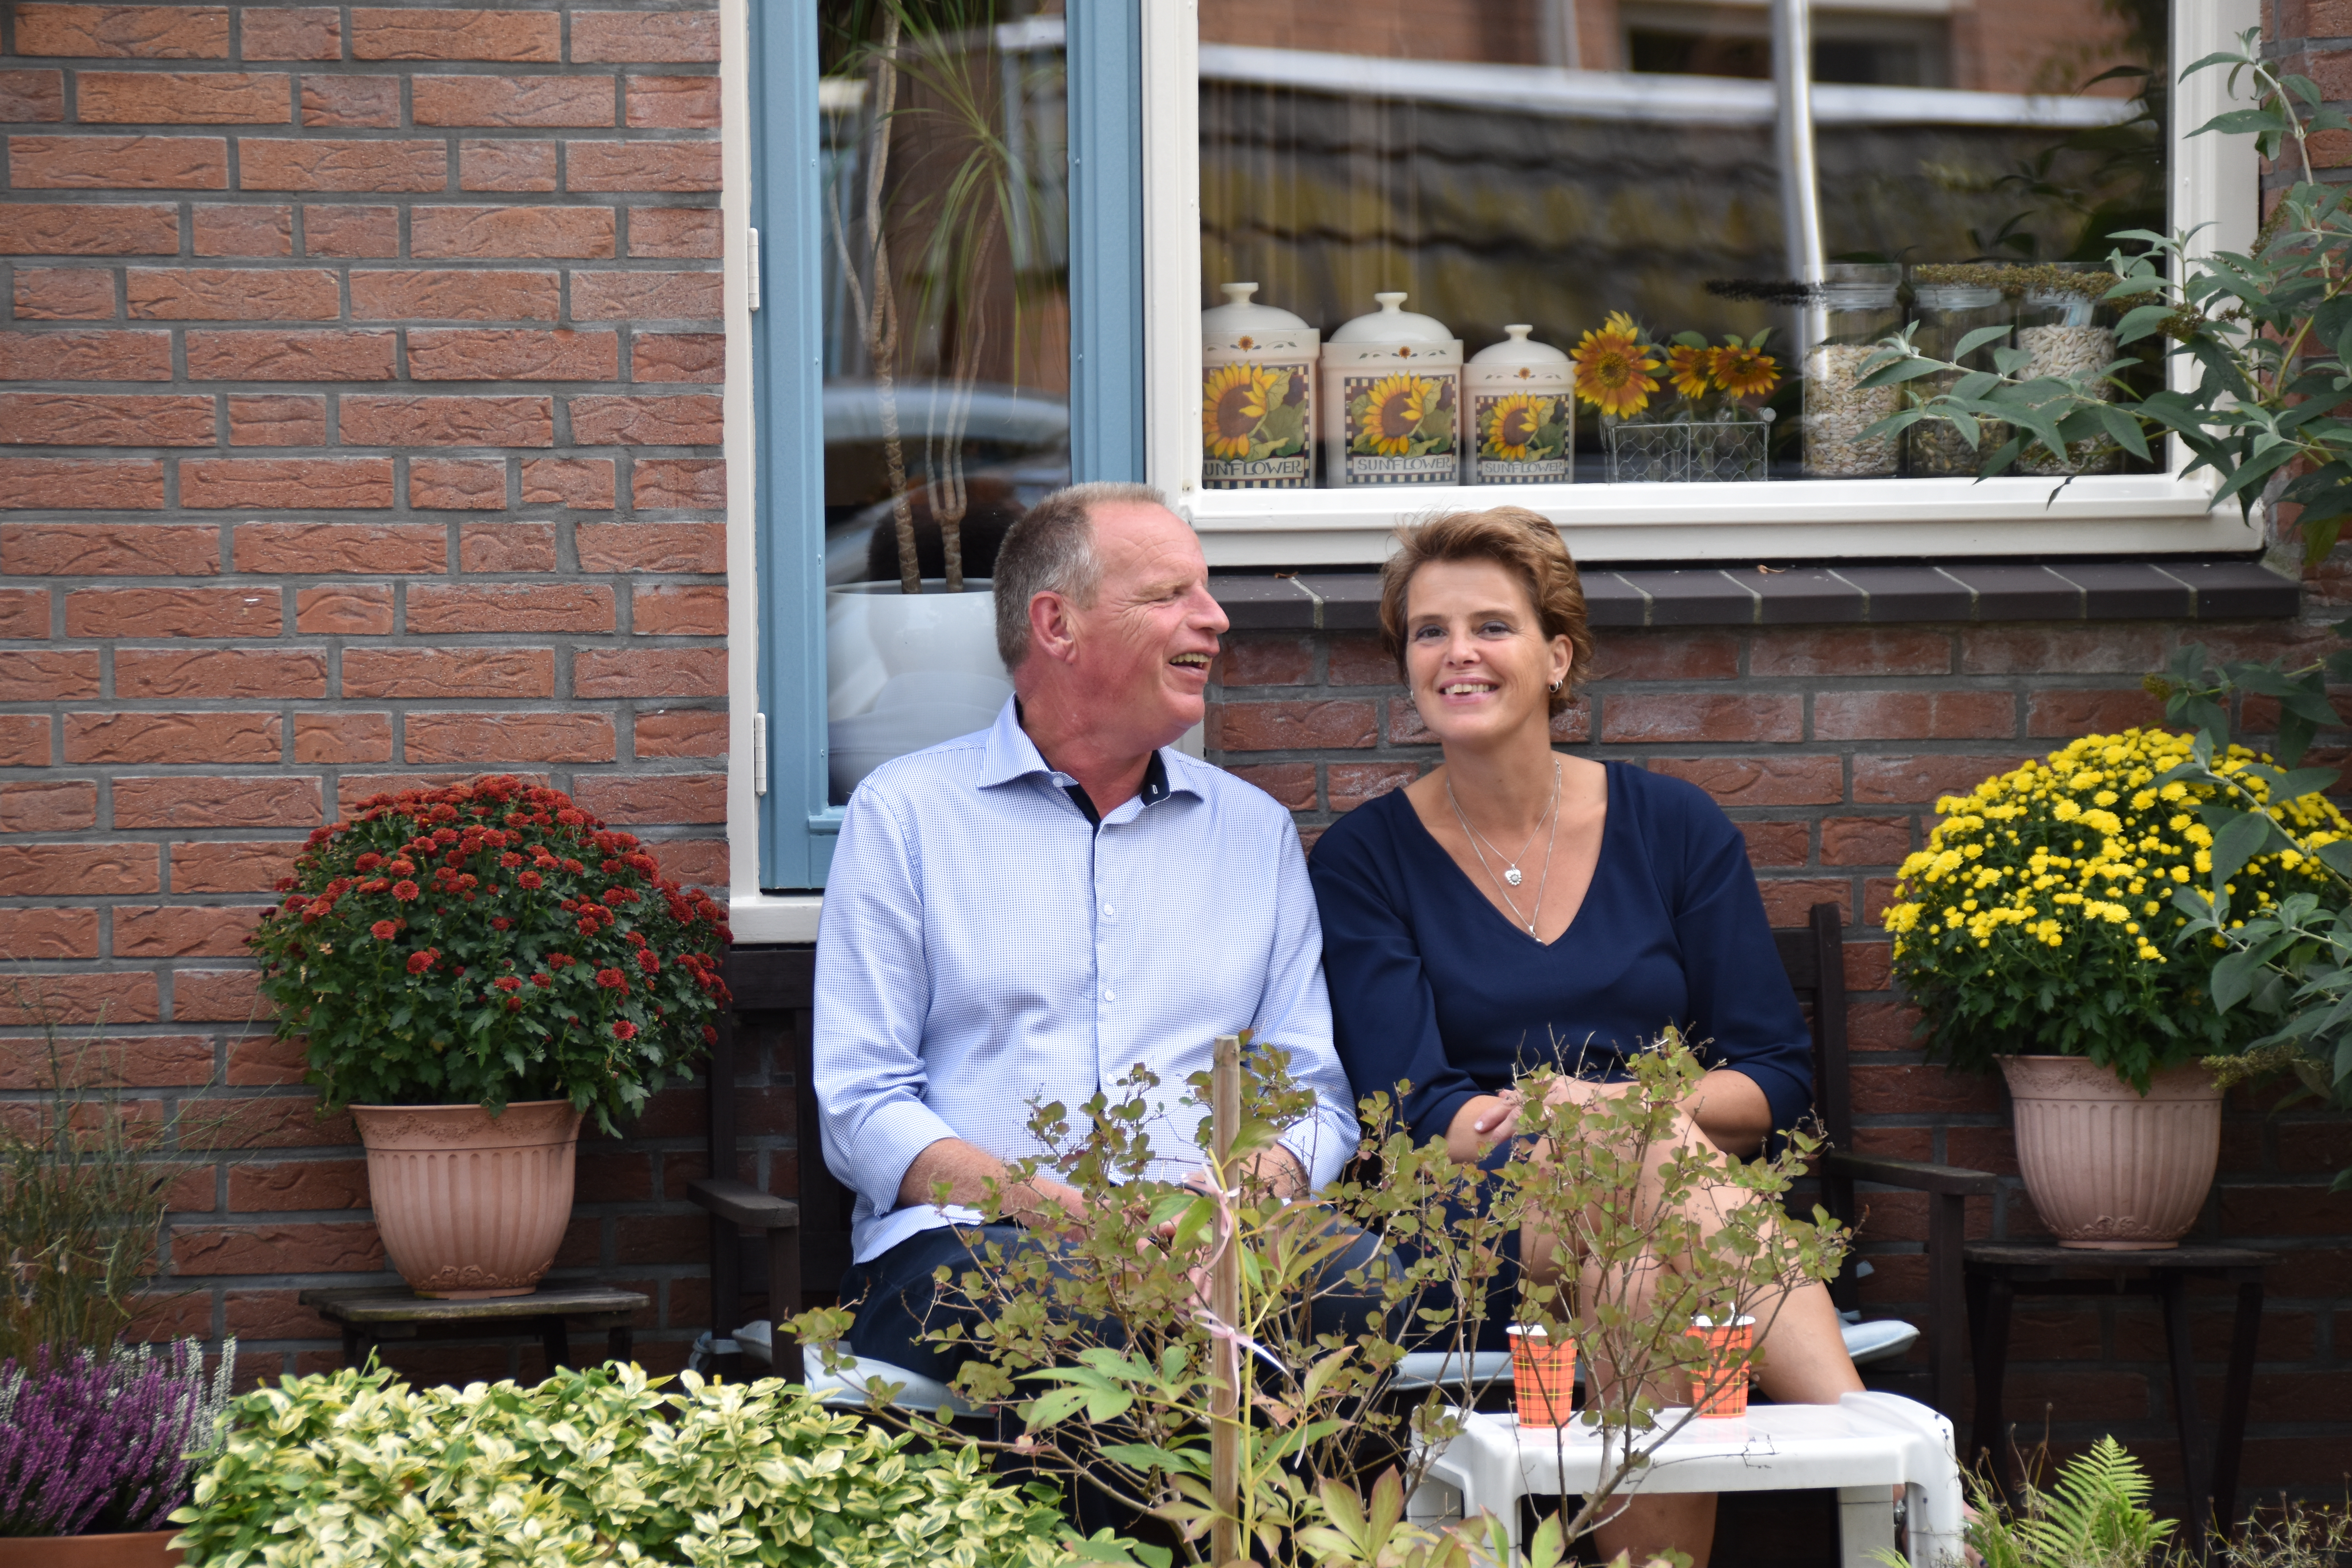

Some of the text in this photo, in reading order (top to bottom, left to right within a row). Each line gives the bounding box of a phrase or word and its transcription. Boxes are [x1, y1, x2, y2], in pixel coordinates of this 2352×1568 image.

[1203, 460, 1303, 475] UNFLOWER
[1358, 457, 1451, 470] SUNFLOWER
[1485, 461, 1564, 473] SUNFLOWER
